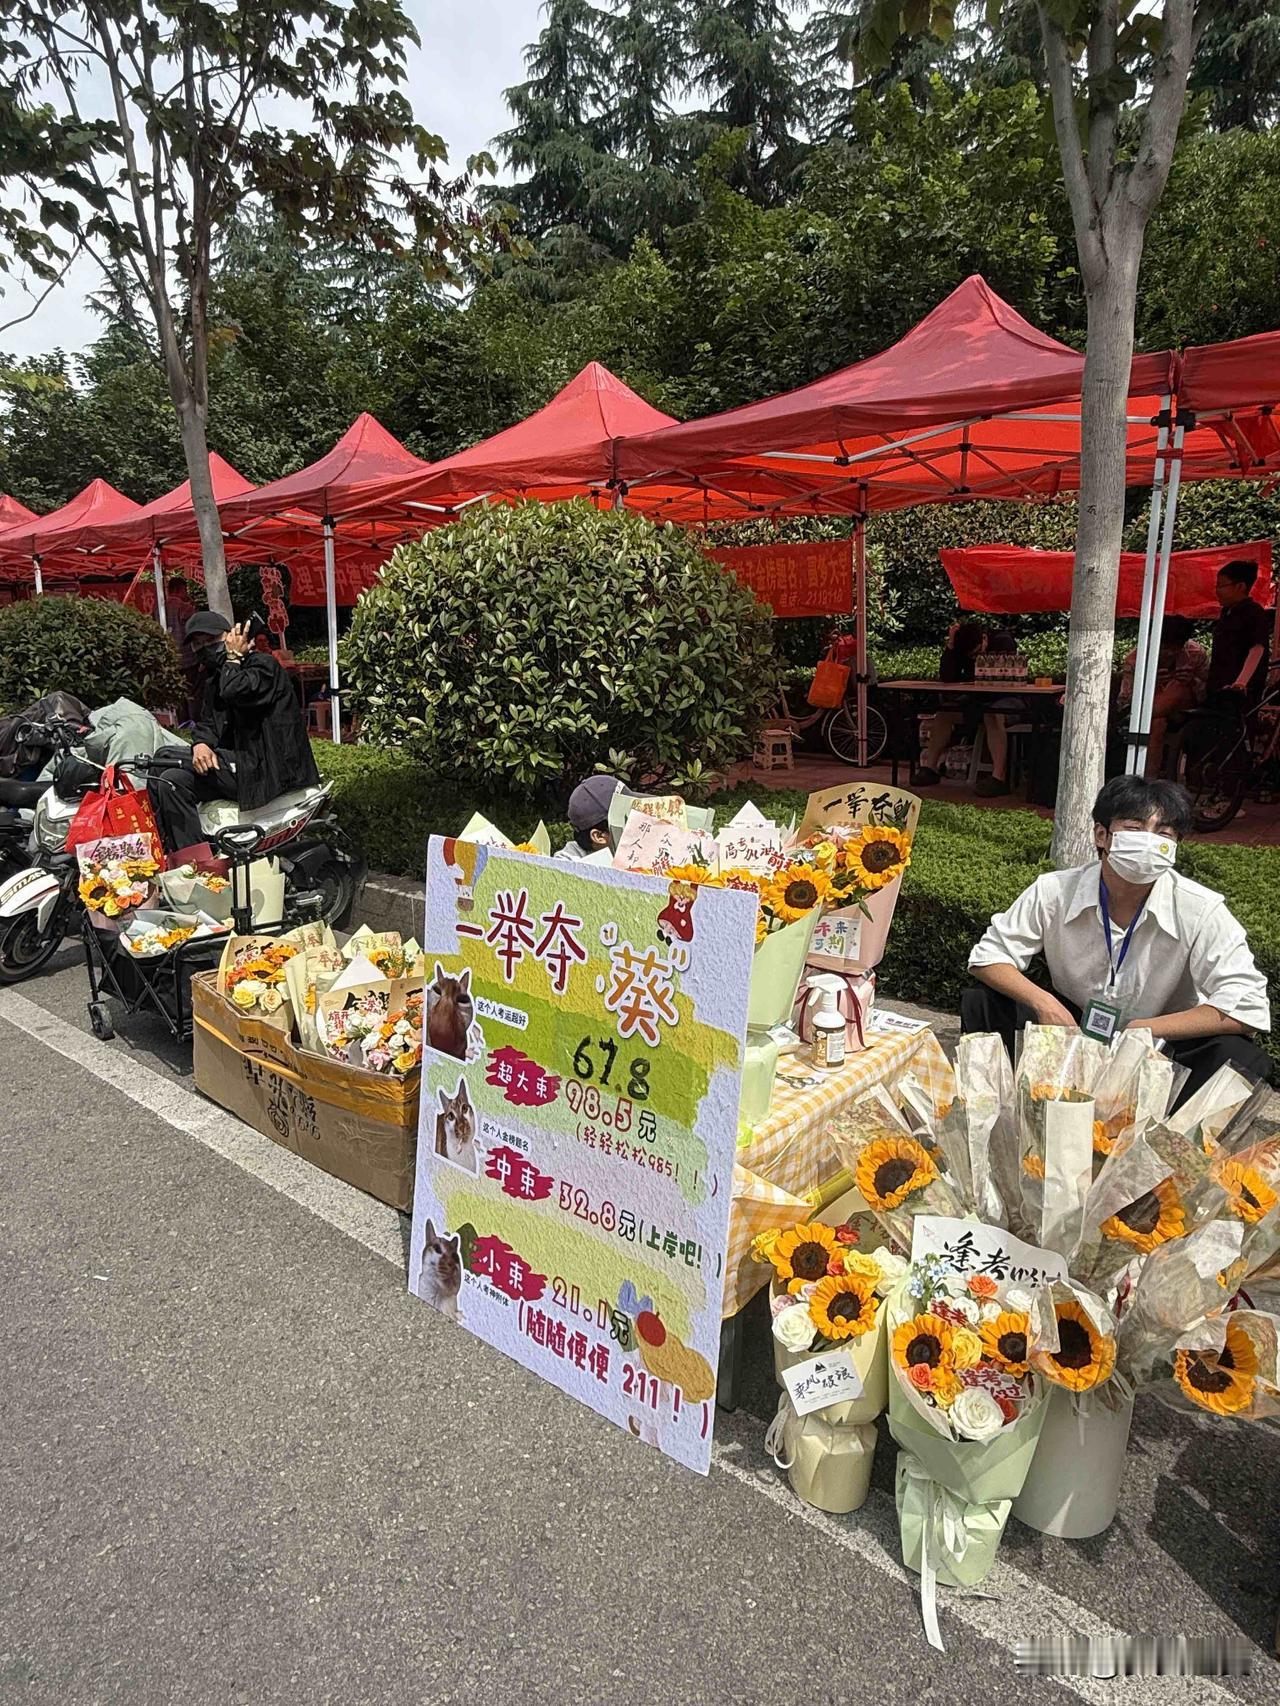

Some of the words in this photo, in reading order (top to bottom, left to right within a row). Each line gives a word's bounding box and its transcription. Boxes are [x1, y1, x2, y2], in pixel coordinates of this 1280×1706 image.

[628, 822, 652, 869] 那人却
[477, 1000, 527, 1027] 这个人考运超好
[497, 1061, 548, 1099] 超大束
[573, 1035, 651, 1101] 67.8
[482, 1122, 529, 1152] 这个人金榜题名
[496, 1153, 535, 1197] 中束
[481, 1249, 524, 1293] 小束
[552, 1276, 631, 1345] 21.1元
